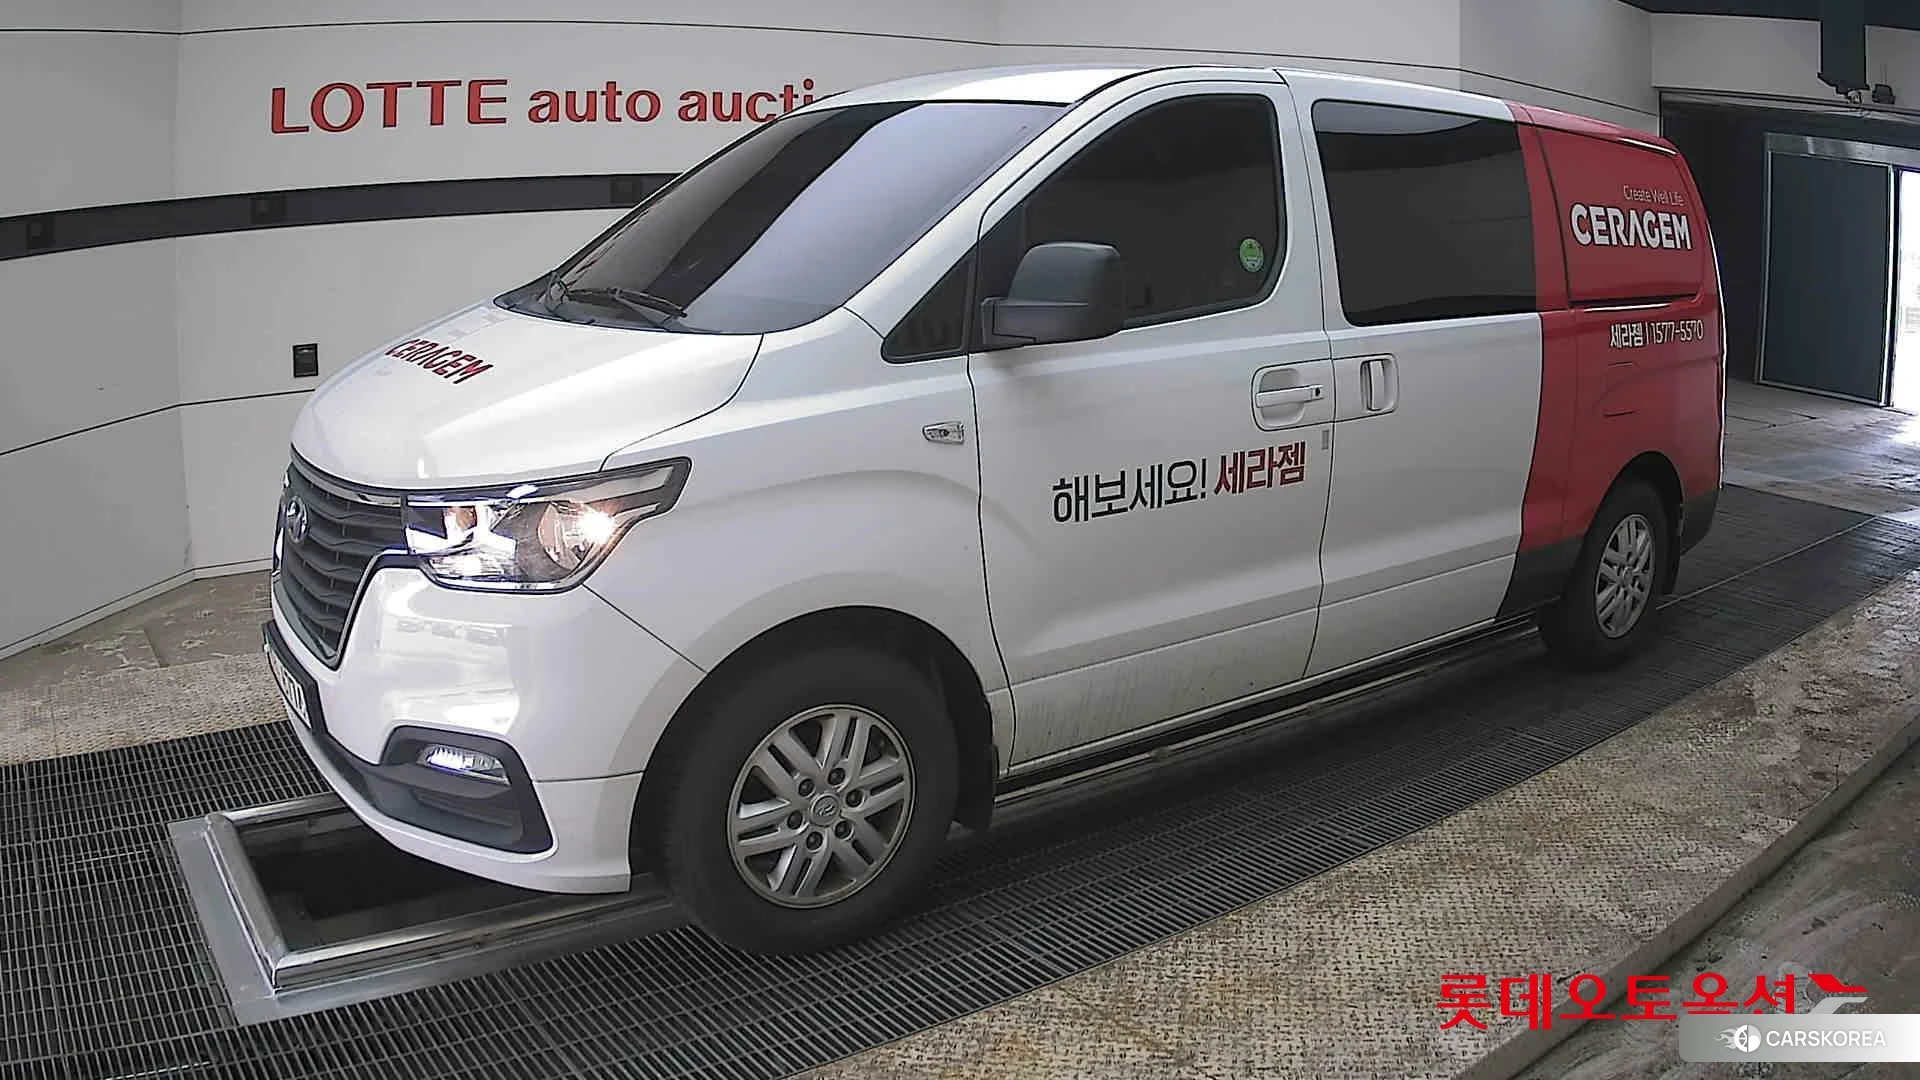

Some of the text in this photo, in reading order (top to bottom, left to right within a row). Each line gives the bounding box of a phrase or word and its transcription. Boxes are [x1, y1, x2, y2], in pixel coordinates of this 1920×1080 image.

[271, 79, 508, 134] LOTTE
[527, 80, 662, 123] auto
[1622, 184, 1651, 203] Create
[1652, 188, 1670, 205] Well
[1570, 203, 1692, 249] CERAGEM
[1610, 319, 1704, 349] 세라젬 1577-5570
[1051, 440, 1306, 523] 해보세요! 세라젬
